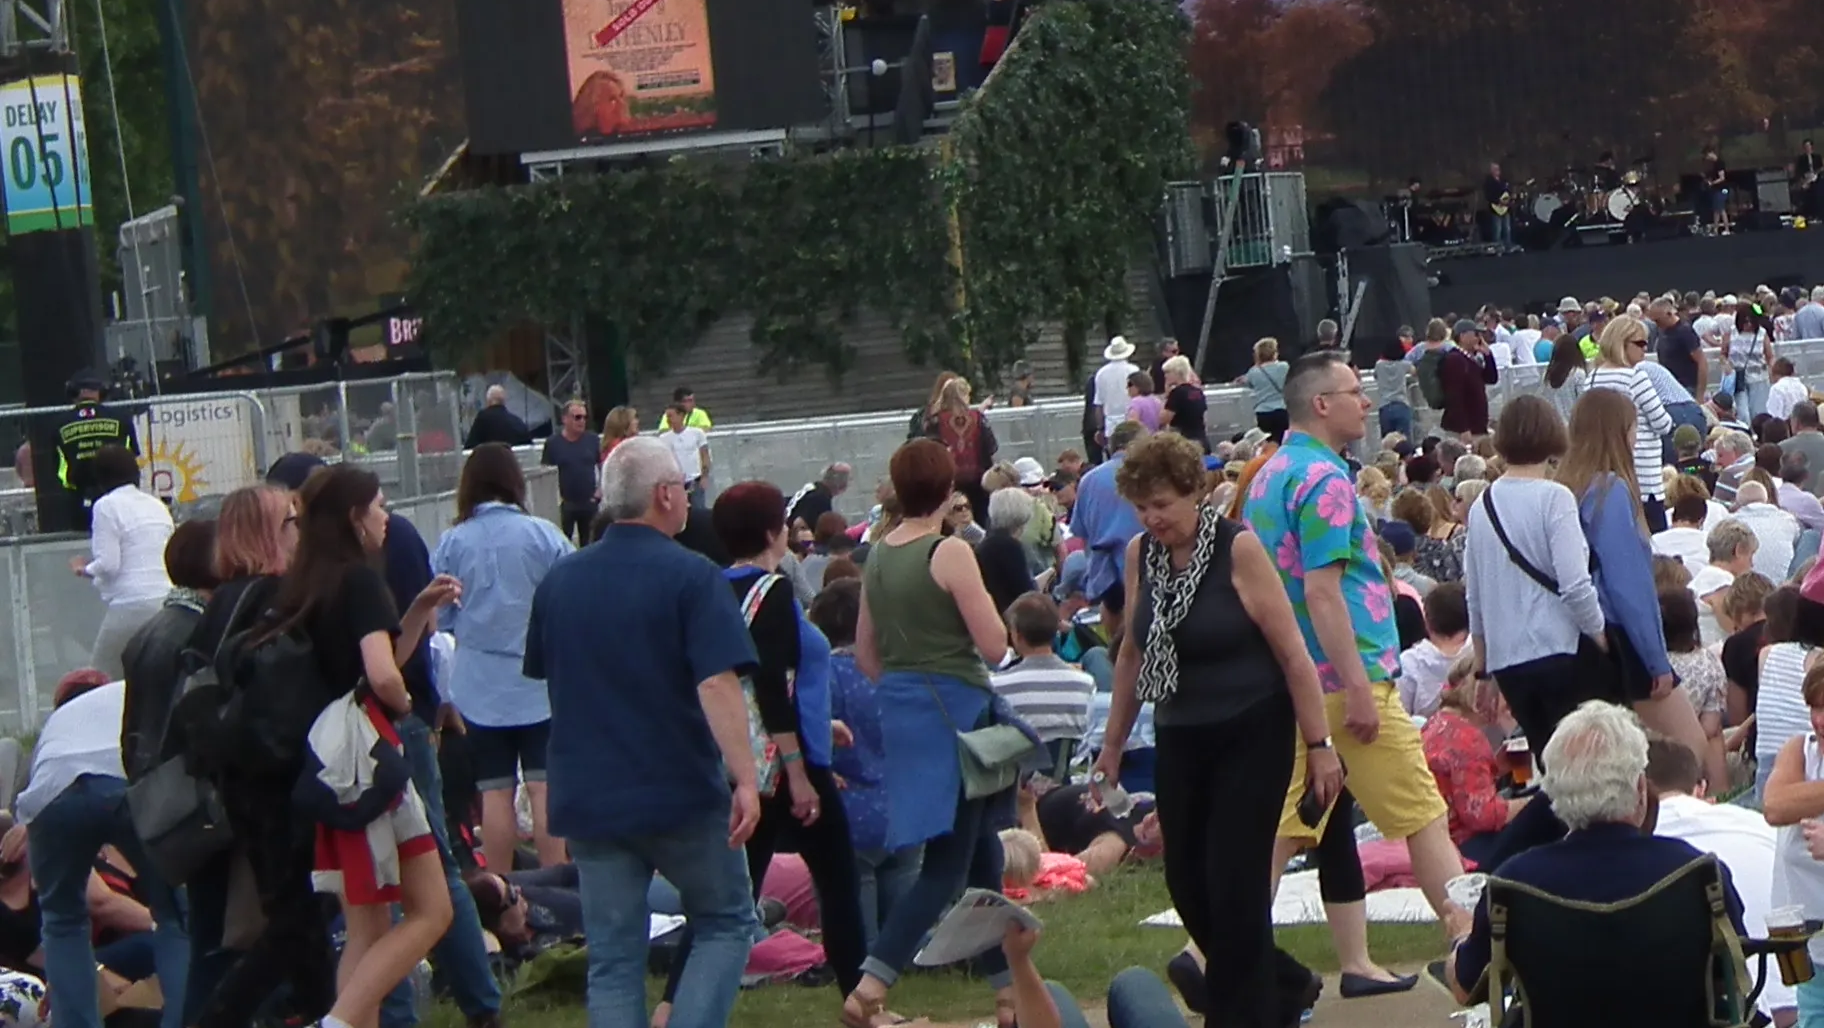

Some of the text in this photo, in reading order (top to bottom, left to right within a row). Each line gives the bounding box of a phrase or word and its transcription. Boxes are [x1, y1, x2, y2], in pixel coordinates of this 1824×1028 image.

[611, 6, 638, 32] SOLD
[6, 100, 57, 128] DELAY
[11, 132, 63, 191] 05
[149, 402, 233, 427] Logistics
[62, 422, 116, 439] SUPERVISOR
